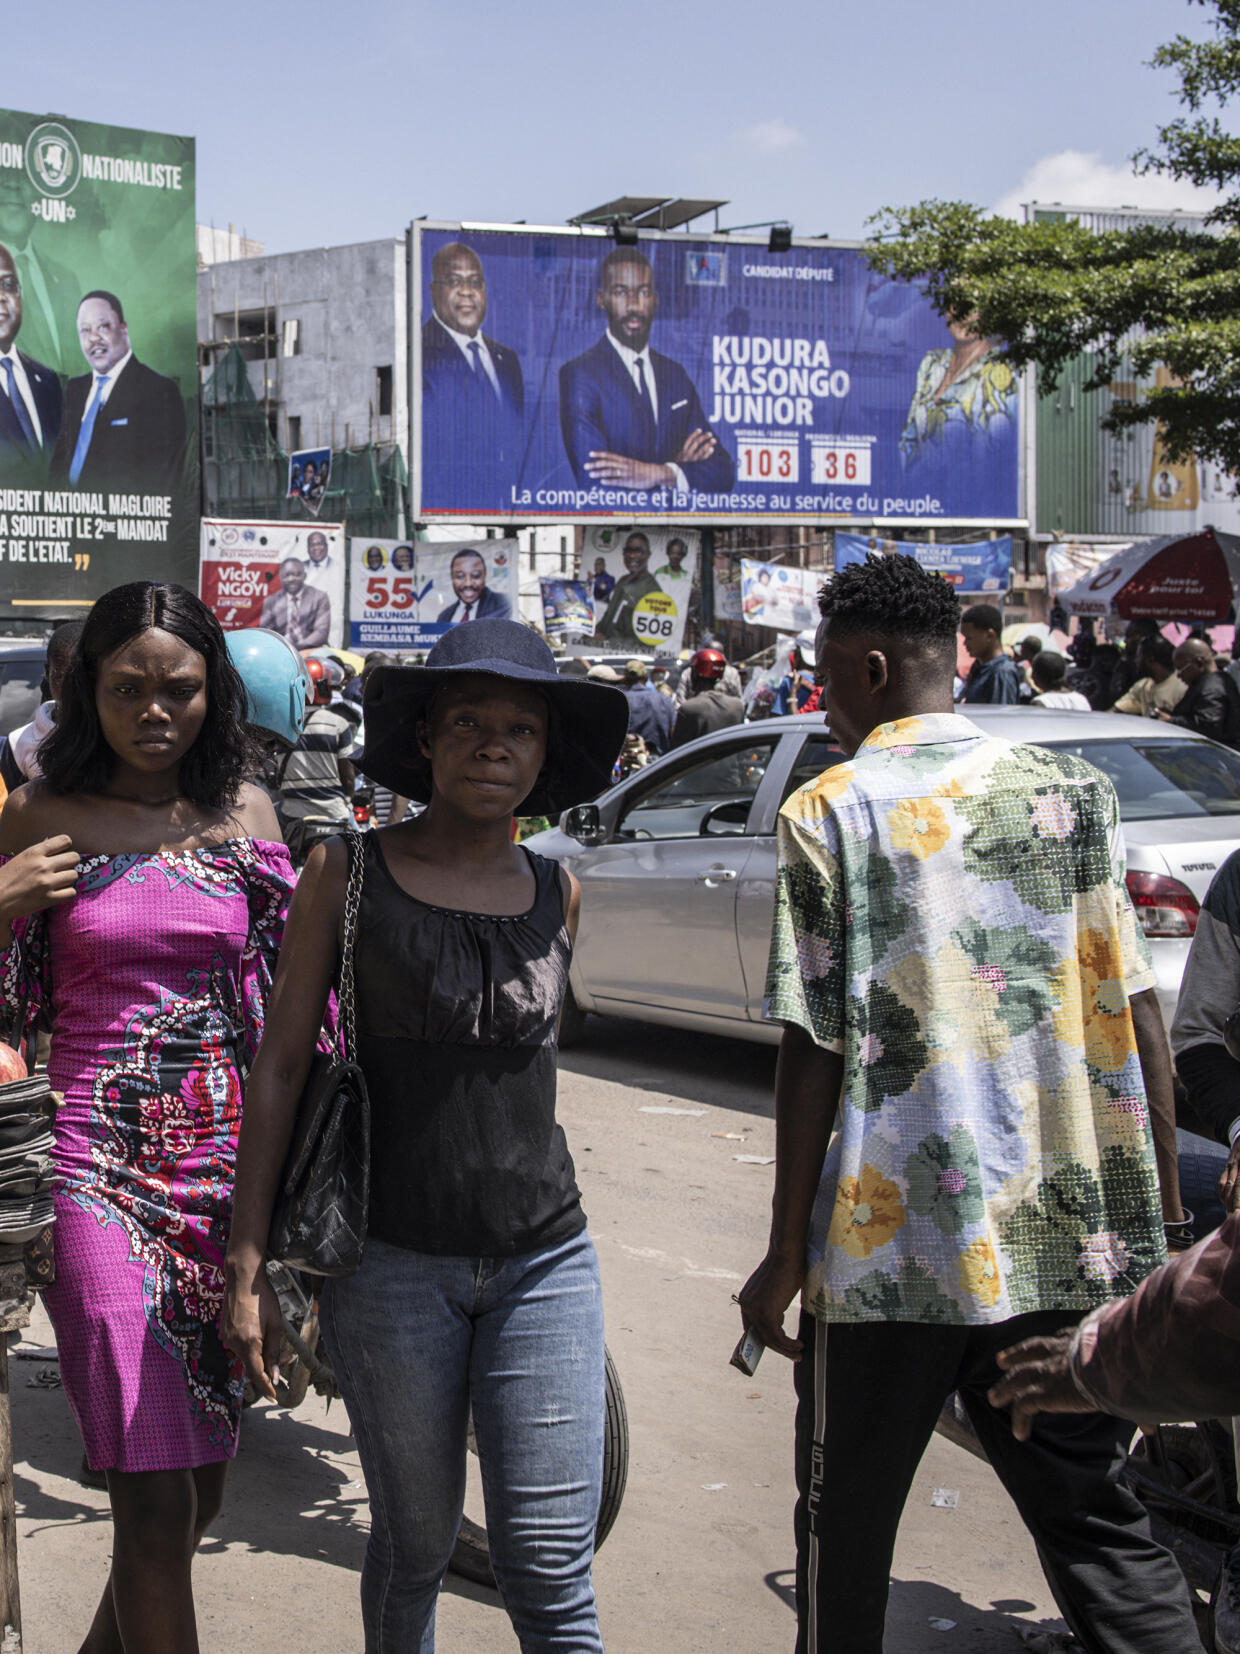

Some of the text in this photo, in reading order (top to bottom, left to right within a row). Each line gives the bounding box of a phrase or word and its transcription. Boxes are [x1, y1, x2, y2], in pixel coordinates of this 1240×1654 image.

[82, 154, 182, 190] NATIONALISTE
[743, 264, 834, 281] CANDIDAT DÉPUTÉ
[712, 335, 830, 368] KUDURA
[713, 365, 850, 398] KASONGO
[709, 395, 813, 425] JUNIOR
[744, 449, 791, 477] 103
[826, 452, 857, 479] 36
[43, 491, 107, 515] NATIONAL
[109, 494, 172, 518] MAGLOIRE
[511, 485, 944, 516] La compétence et la jeunesse au service du peuple.
[11, 516, 74, 538] SOUTIENT
[76, 518, 92, 539] LE
[117, 519, 168, 541] MANDAT
[9, 540, 26, 562] DE
[217, 567, 261, 585] Vicky
[218, 582, 268, 597] NGOYI
[365, 577, 415, 609] 55
[363, 611, 415, 619] LUKUNGA
[636, 617, 673, 636] 508
[360, 624, 421, 634] GUILLAUME
